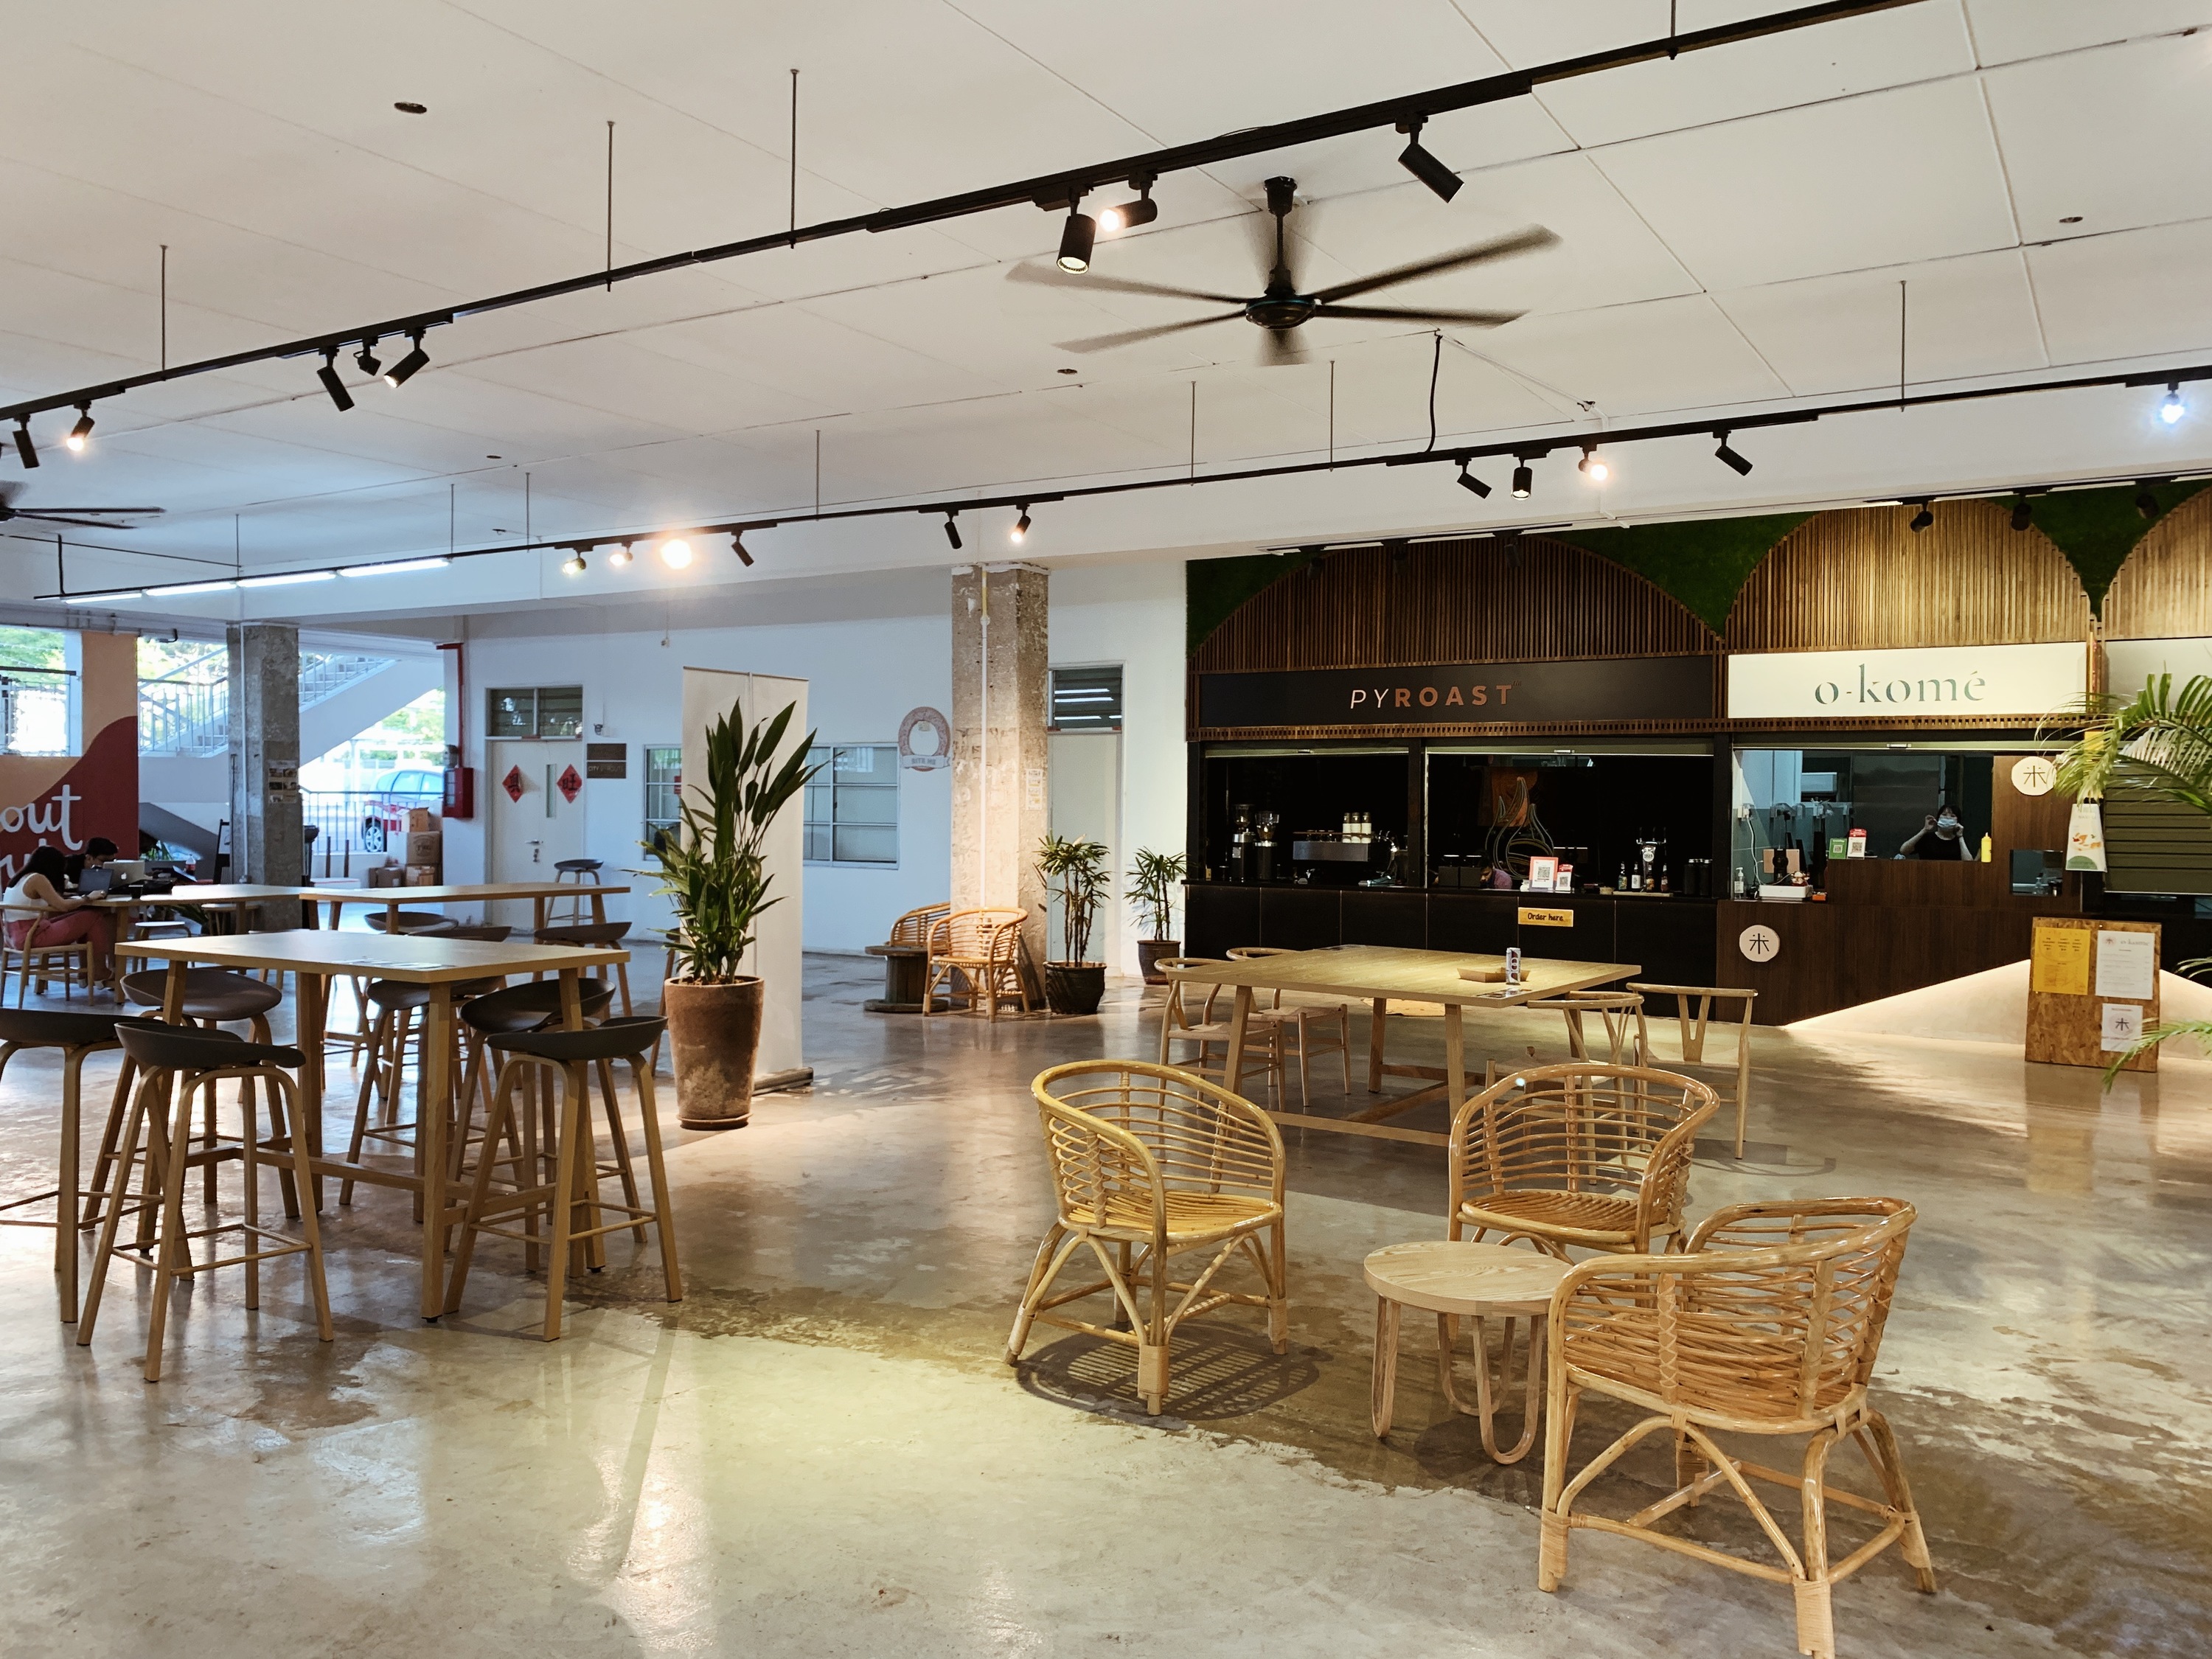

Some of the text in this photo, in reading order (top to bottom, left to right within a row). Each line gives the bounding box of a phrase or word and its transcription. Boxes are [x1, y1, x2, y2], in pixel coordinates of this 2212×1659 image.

[1815, 663, 1986, 705] o-komé
[1350, 685, 1512, 709] PYROAST
[1527, 912, 1564, 921] Order here
